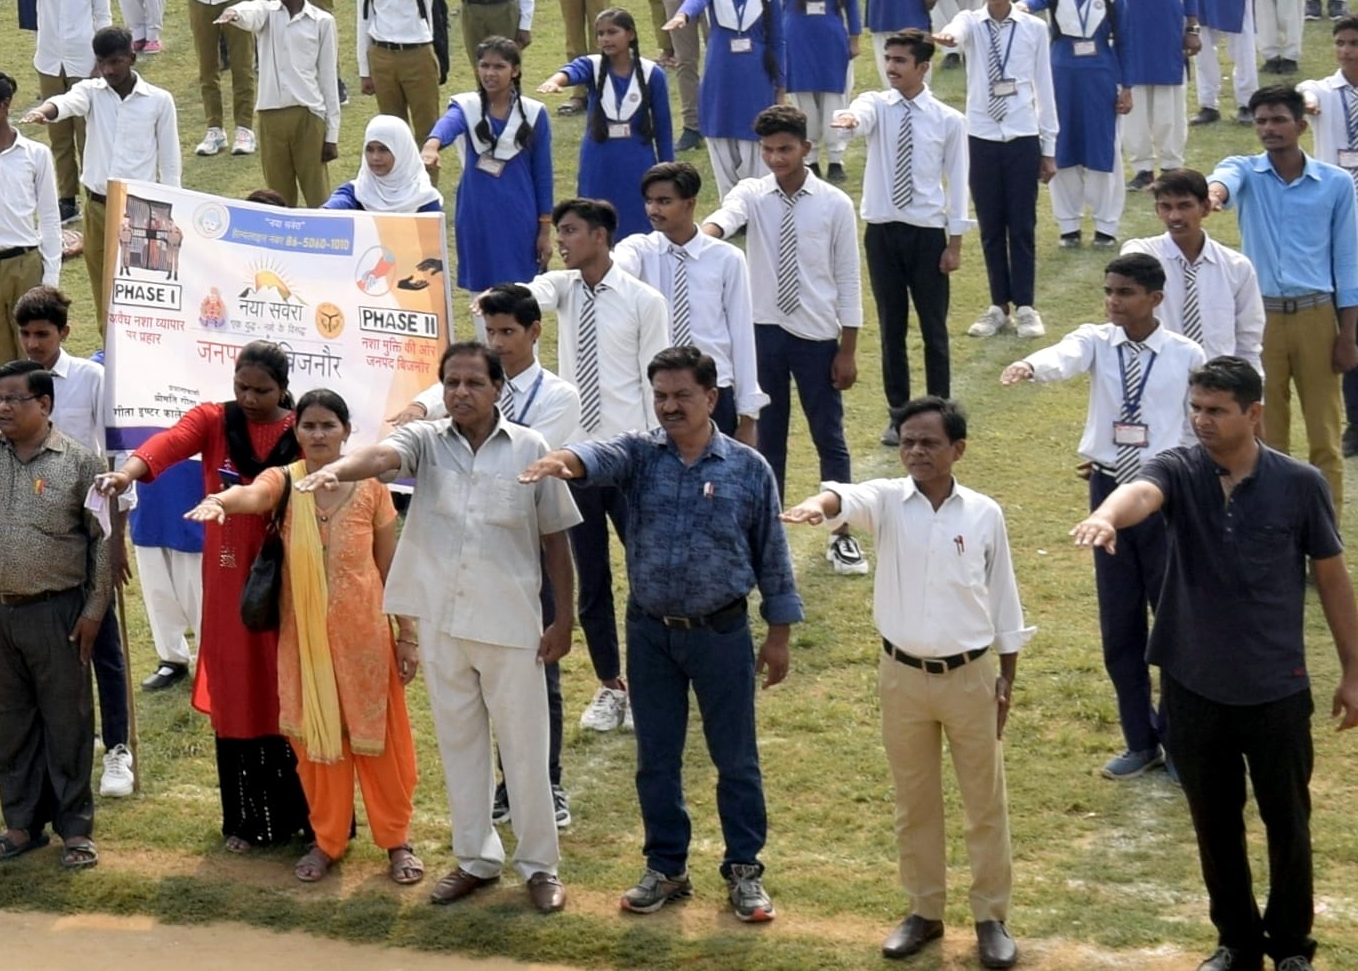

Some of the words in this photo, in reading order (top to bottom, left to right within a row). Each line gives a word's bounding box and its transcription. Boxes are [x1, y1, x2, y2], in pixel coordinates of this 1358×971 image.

[115, 283, 165, 303] PHASE
[170, 289, 175, 304] I
[239, 299, 266, 318] नया
[269, 300, 304, 322] सवेरा
[108, 312, 131, 326] अवैध
[133, 316, 154, 329] नशा
[156, 317, 186, 331] व्यापार
[363, 309, 418, 333] PHASE
[425, 316, 435, 334] II
[126, 329, 138, 341] पर
[139, 331, 162, 345] प्रहार
[362, 337, 380, 350] नशा
[383, 337, 402, 356] मुक्ति
[404, 339, 416, 353] की
[419, 340, 436, 356] ओर
[197, 340, 244, 366] जनप
[366, 355, 395, 370] जनपद
[397, 356, 431, 374] बिजनौर
[163, 407, 187, 419] काले
